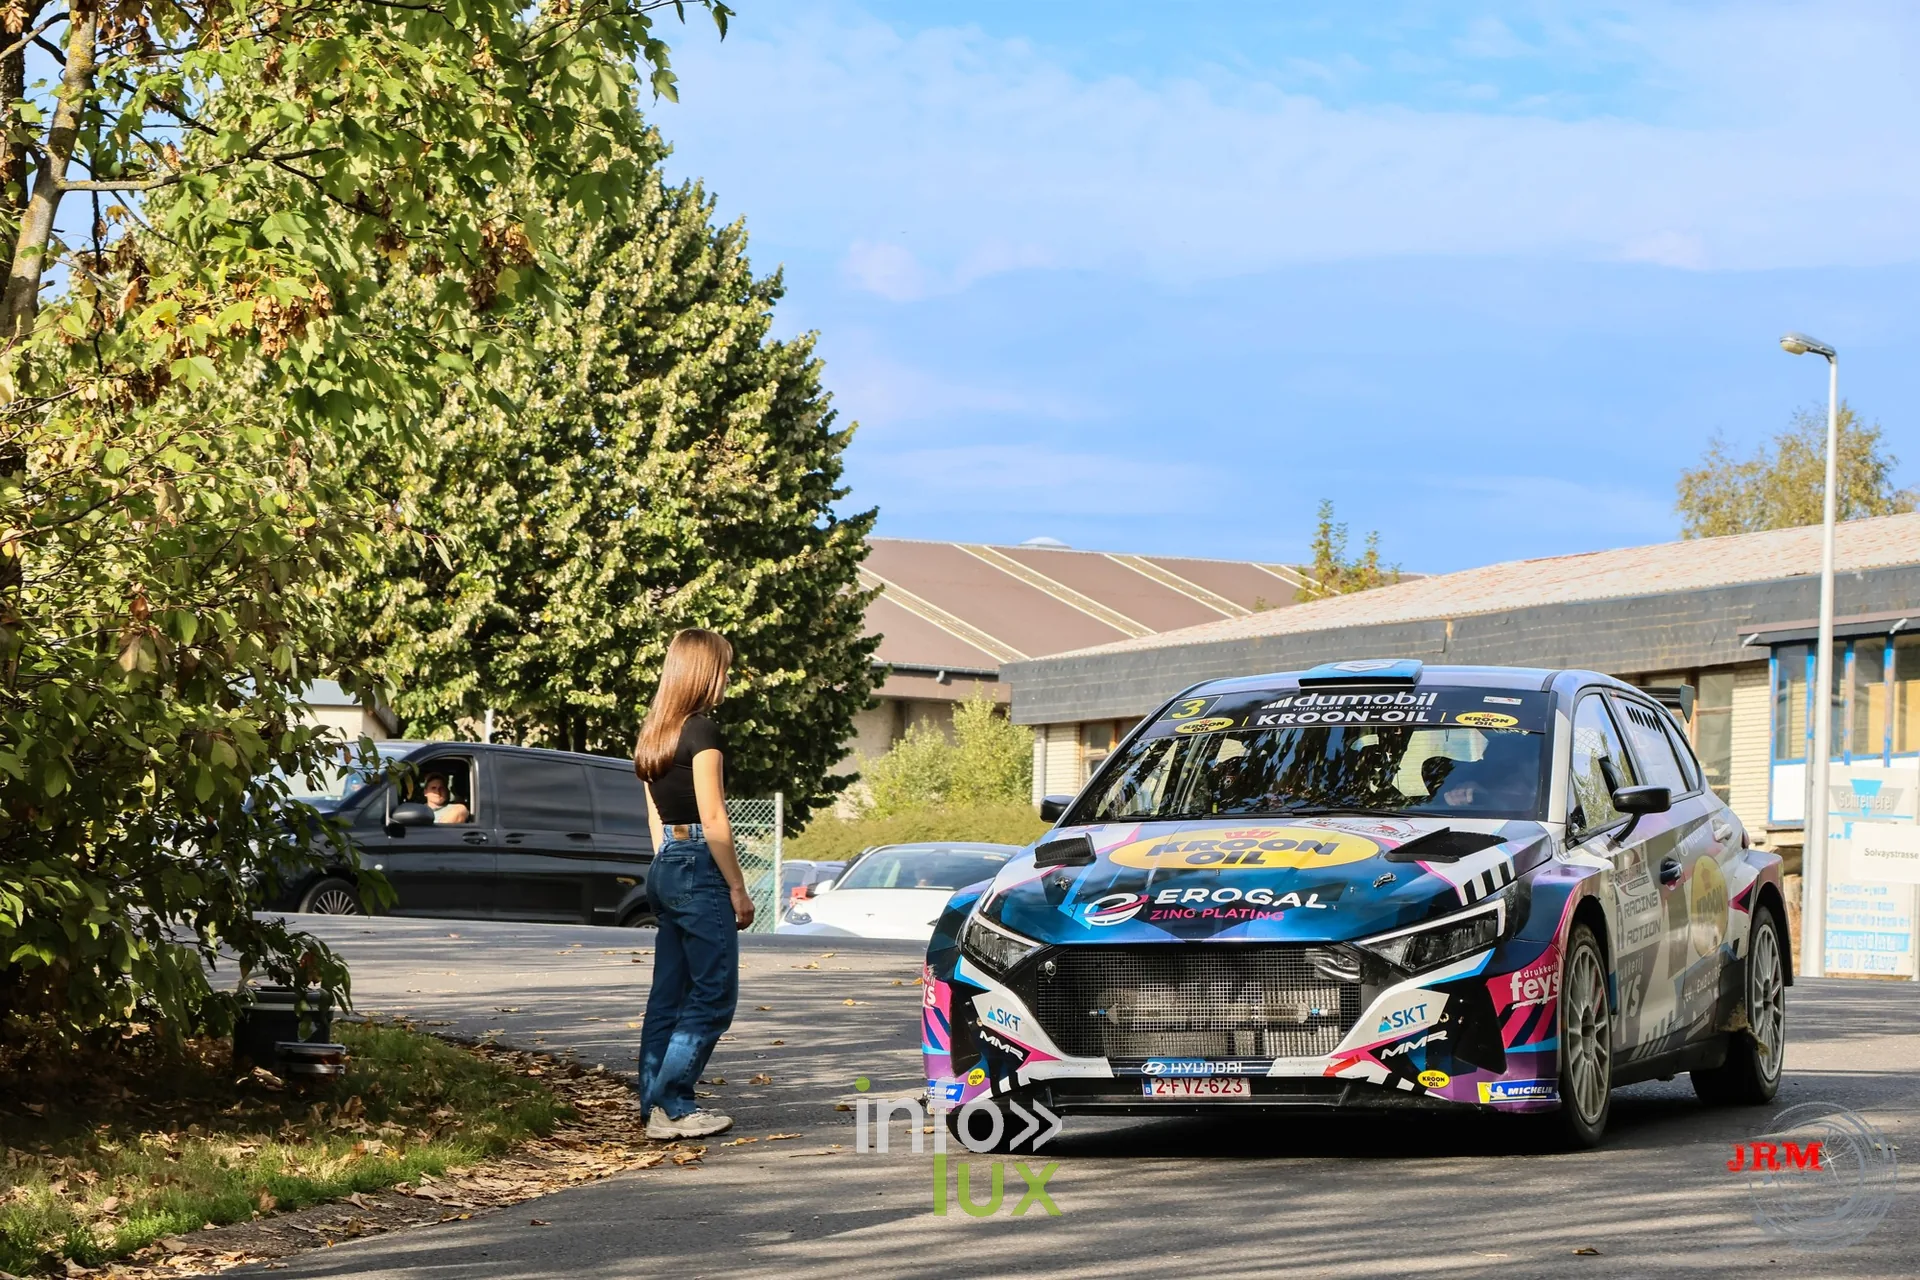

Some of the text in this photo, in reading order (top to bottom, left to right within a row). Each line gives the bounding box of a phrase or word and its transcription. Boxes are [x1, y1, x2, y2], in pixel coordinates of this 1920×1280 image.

[1293, 691, 1438, 707] dumobil
[1171, 699, 1206, 719] 3
[1183, 721, 1225, 730] KROON
[1256, 711, 1429, 726] KROON-OIL
[1464, 716, 1509, 724] KROON
[1838, 791, 1895, 811] Schreinerei
[1144, 838, 1341, 856] KROON
[1864, 847, 1920, 860] Solvaystrasse
[1184, 849, 1267, 865] OIL
[1153, 887, 1328, 910] EROGAL
[1623, 891, 1659, 919] RACING
[1149, 907, 1285, 922] ZINC PLATING
[1626, 918, 1662, 946] ACTION
[1523, 961, 1558, 979] drukkerij
[1510, 971, 1560, 1003] feys
[996, 1008, 1022, 1032] SKT
[1391, 1003, 1428, 1028] SKT
[1170, 1062, 1243, 1074] HYUNDAI
[1155, 1078, 1243, 1094] 2-FVZ-623
[1507, 1086, 1553, 1096] MICHELIN
